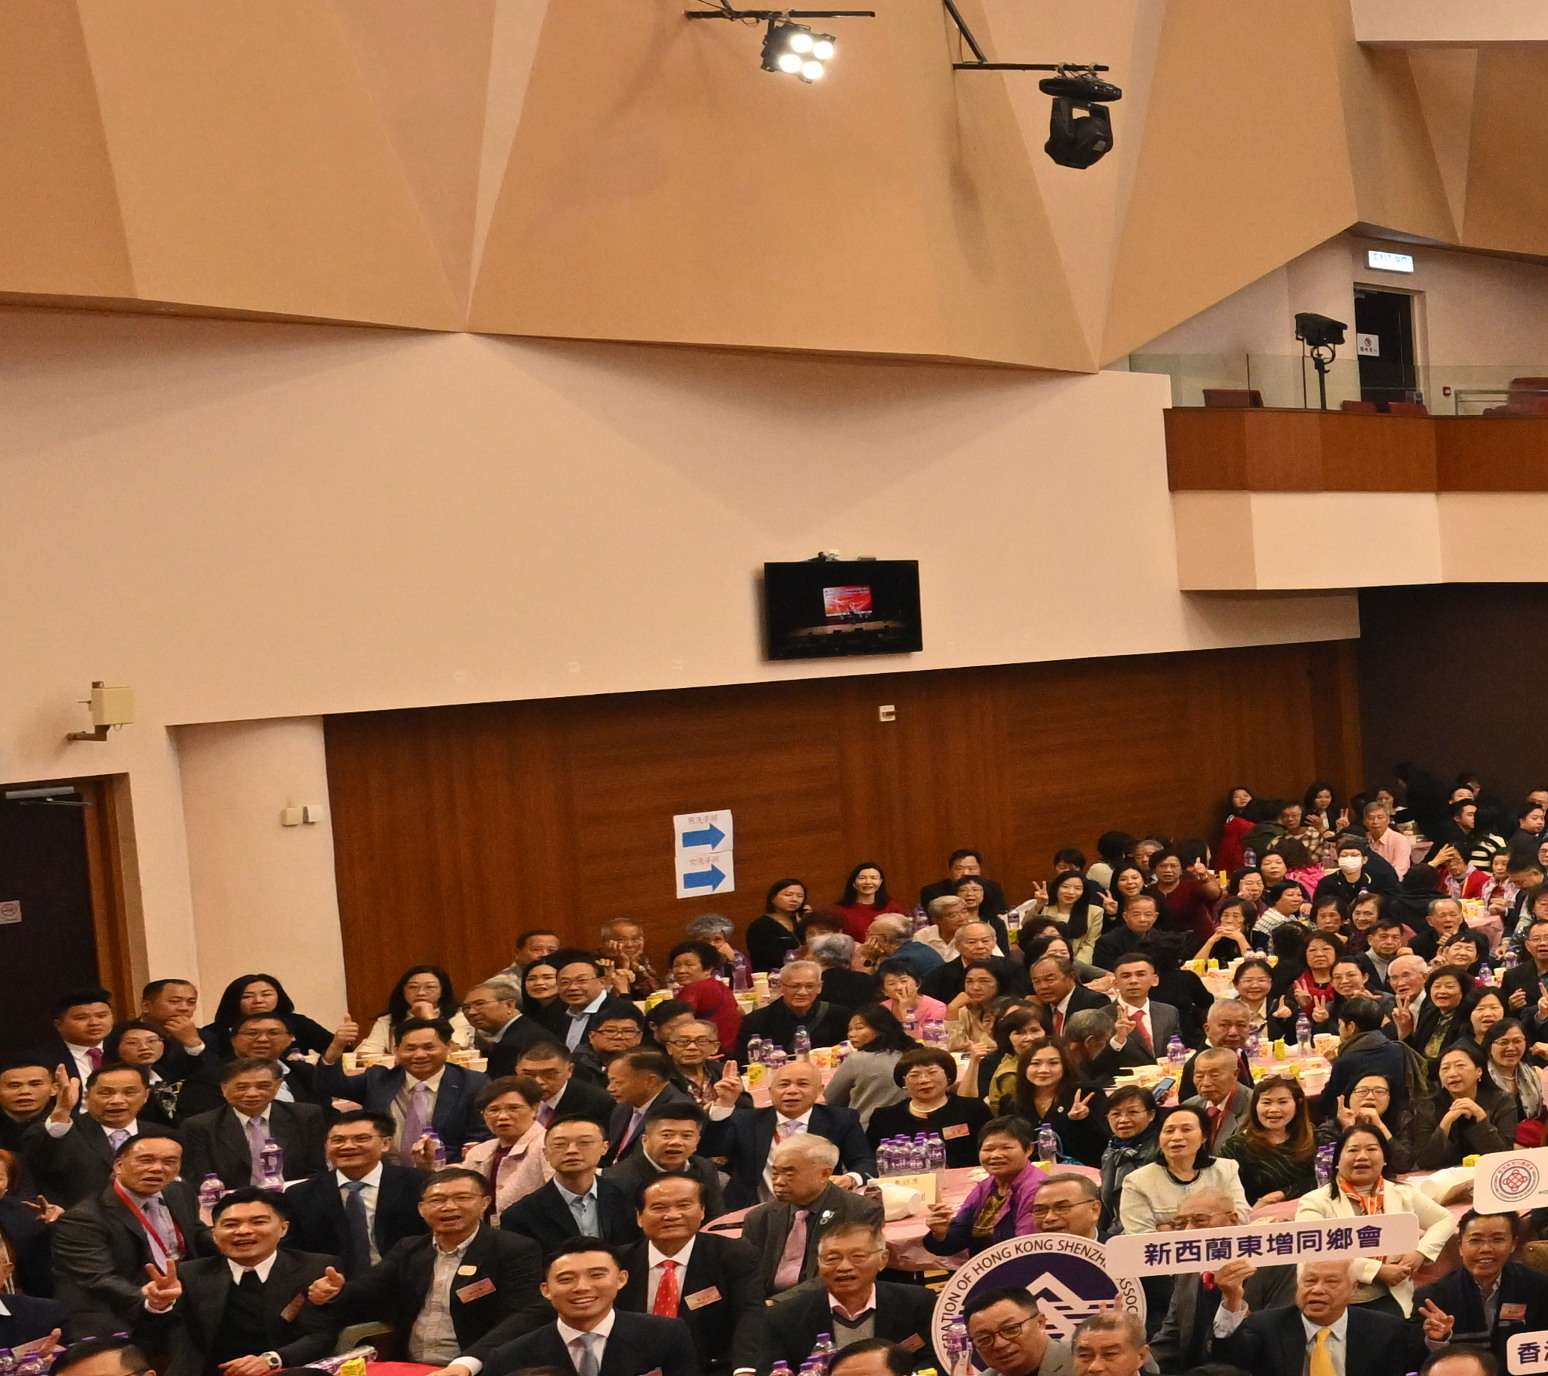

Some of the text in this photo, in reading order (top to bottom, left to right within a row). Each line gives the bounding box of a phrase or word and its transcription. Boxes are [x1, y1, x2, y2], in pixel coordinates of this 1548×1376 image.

[973, 1248, 1012, 1275] HONG
[1015, 1239, 1053, 1254] KONG
[1057, 1240, 1107, 1269] SHENZH
[1144, 1224, 1384, 1267] 新西蘭東增同鄉會
